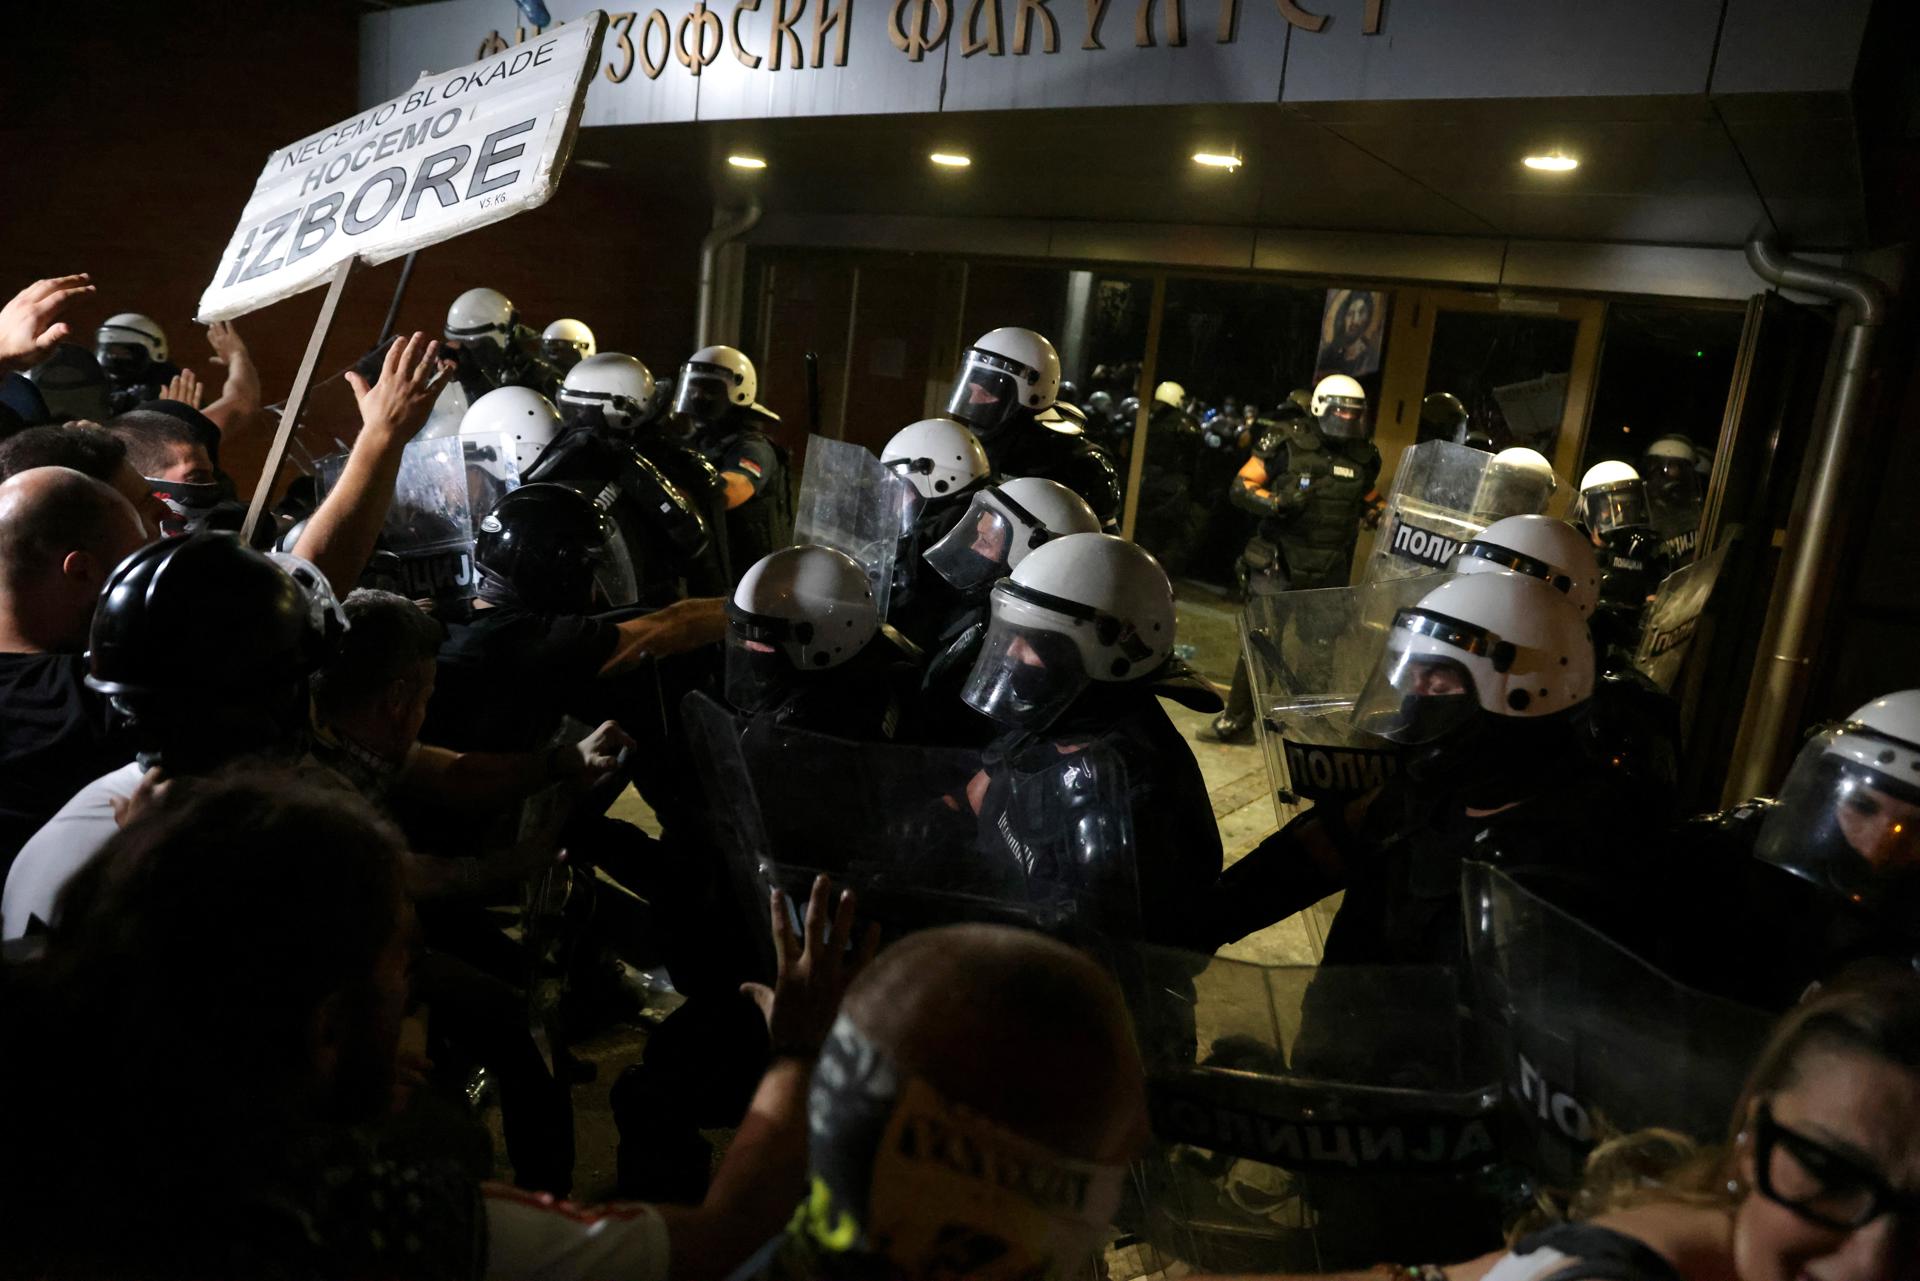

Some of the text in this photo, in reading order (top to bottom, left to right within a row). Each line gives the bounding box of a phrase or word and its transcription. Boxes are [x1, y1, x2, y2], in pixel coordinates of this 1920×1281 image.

[402, 39, 558, 114] BLOKADE
[300, 108, 463, 197] HOĆEMO
[222, 117, 537, 288] IZBORE
